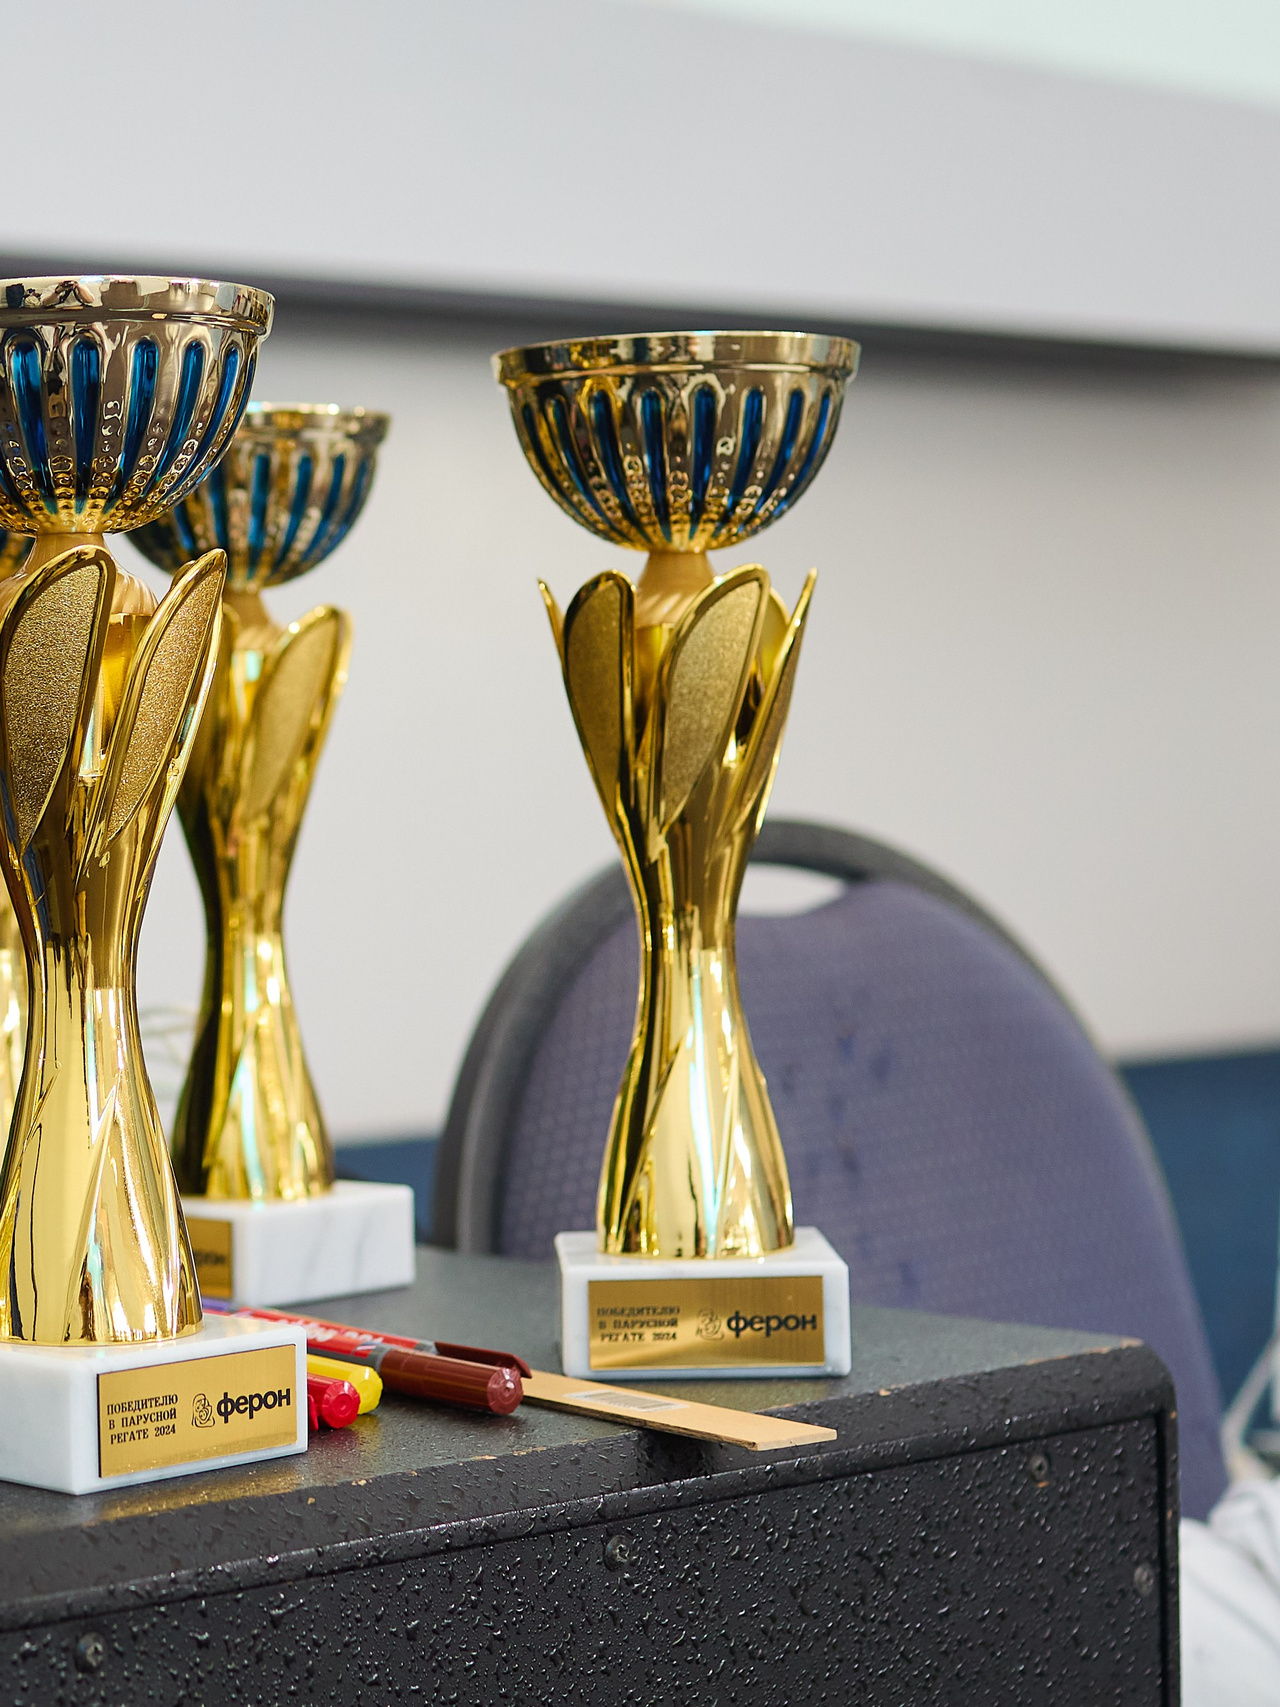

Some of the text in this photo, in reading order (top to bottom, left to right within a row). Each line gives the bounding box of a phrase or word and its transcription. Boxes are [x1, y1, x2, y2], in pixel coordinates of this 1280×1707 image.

[727, 1310, 817, 1338] ферон
[107, 1394, 178, 1415] ПОБЕДИТЕЛЮ
[216, 1388, 291, 1424] ферон
[109, 1408, 177, 1430] В ПАРУСНОЙ
[110, 1423, 176, 1445] РЕГАТЕ 2024
